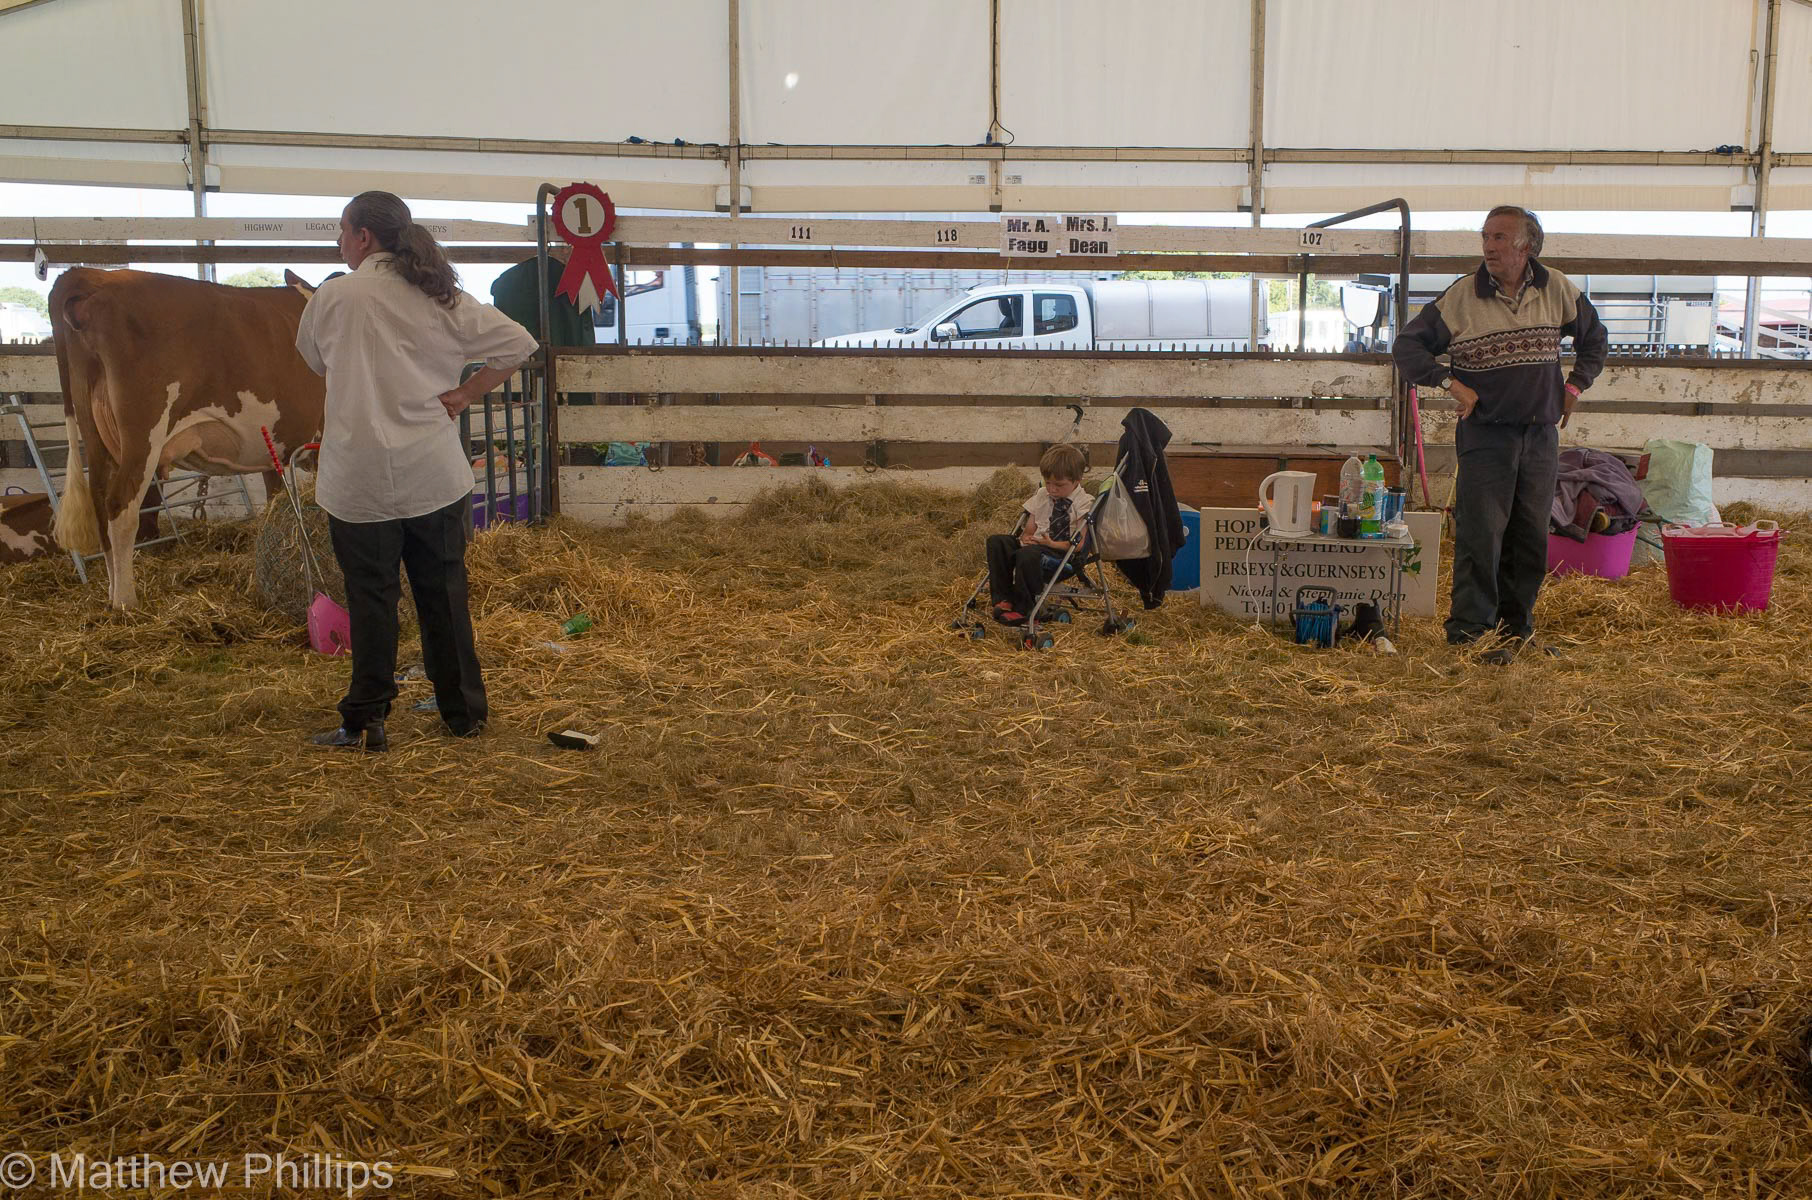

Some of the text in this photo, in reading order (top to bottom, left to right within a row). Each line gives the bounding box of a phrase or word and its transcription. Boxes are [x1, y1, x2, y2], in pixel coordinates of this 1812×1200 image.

[573, 198, 591, 233] 1
[244, 223, 283, 232] HIGHWAY
[305, 223, 336, 231] LEGACY
[1007, 219, 1050, 233] Mr. A.
[1066, 216, 1112, 232] Mrs. J.
[791, 226, 811, 240] 111
[937, 229, 957, 242] 118
[1303, 232, 1322, 246] 107
[1008, 238, 1048, 254] Fagg
[1069, 238, 1108, 254] Dean
[1214, 561, 1275, 578] JERSEYS
[1227, 585, 1273, 598] Nicola
[1279, 586, 1293, 598] &
[1240, 600, 1270, 614] Tel:
